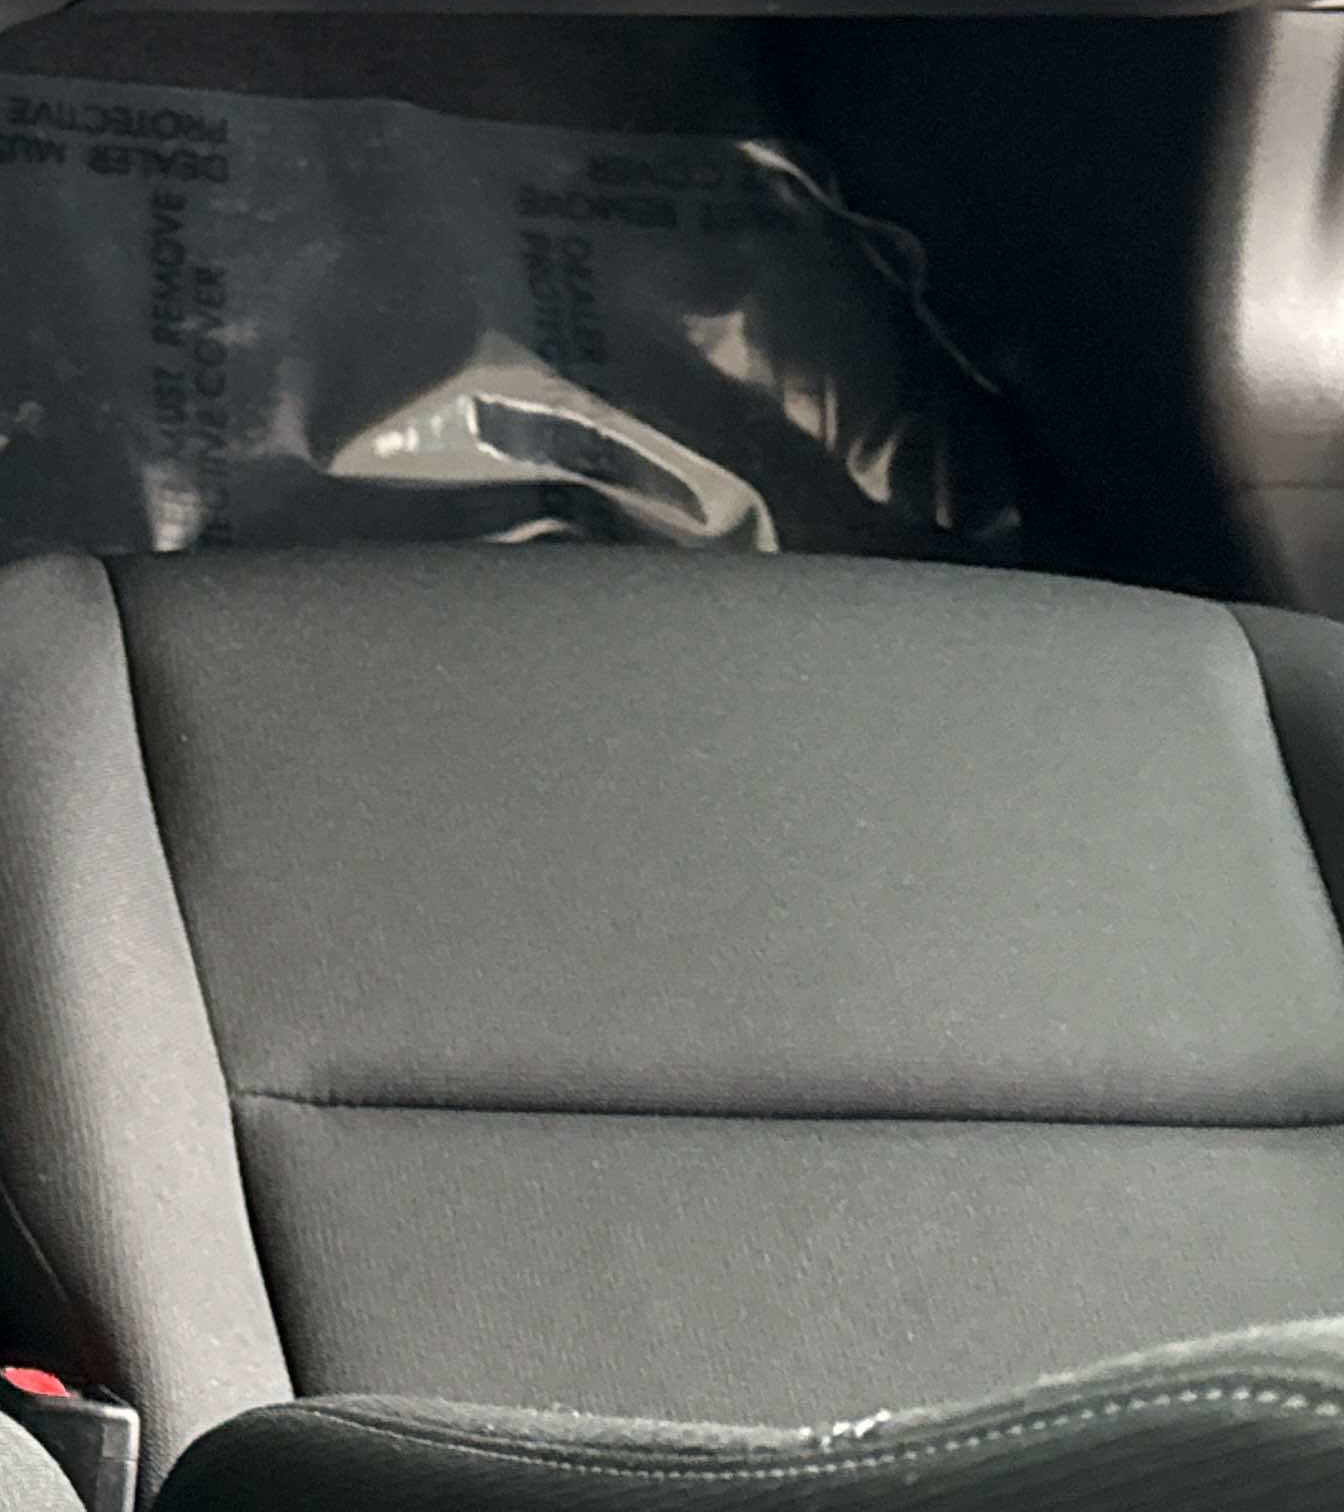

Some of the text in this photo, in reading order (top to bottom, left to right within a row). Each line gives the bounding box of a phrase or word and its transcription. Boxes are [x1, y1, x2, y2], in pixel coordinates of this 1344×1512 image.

[8, 97, 229, 145] PROTECTIVE
[87, 145, 229, 184] DEALER
[145, 190, 185, 347] REMOVE
